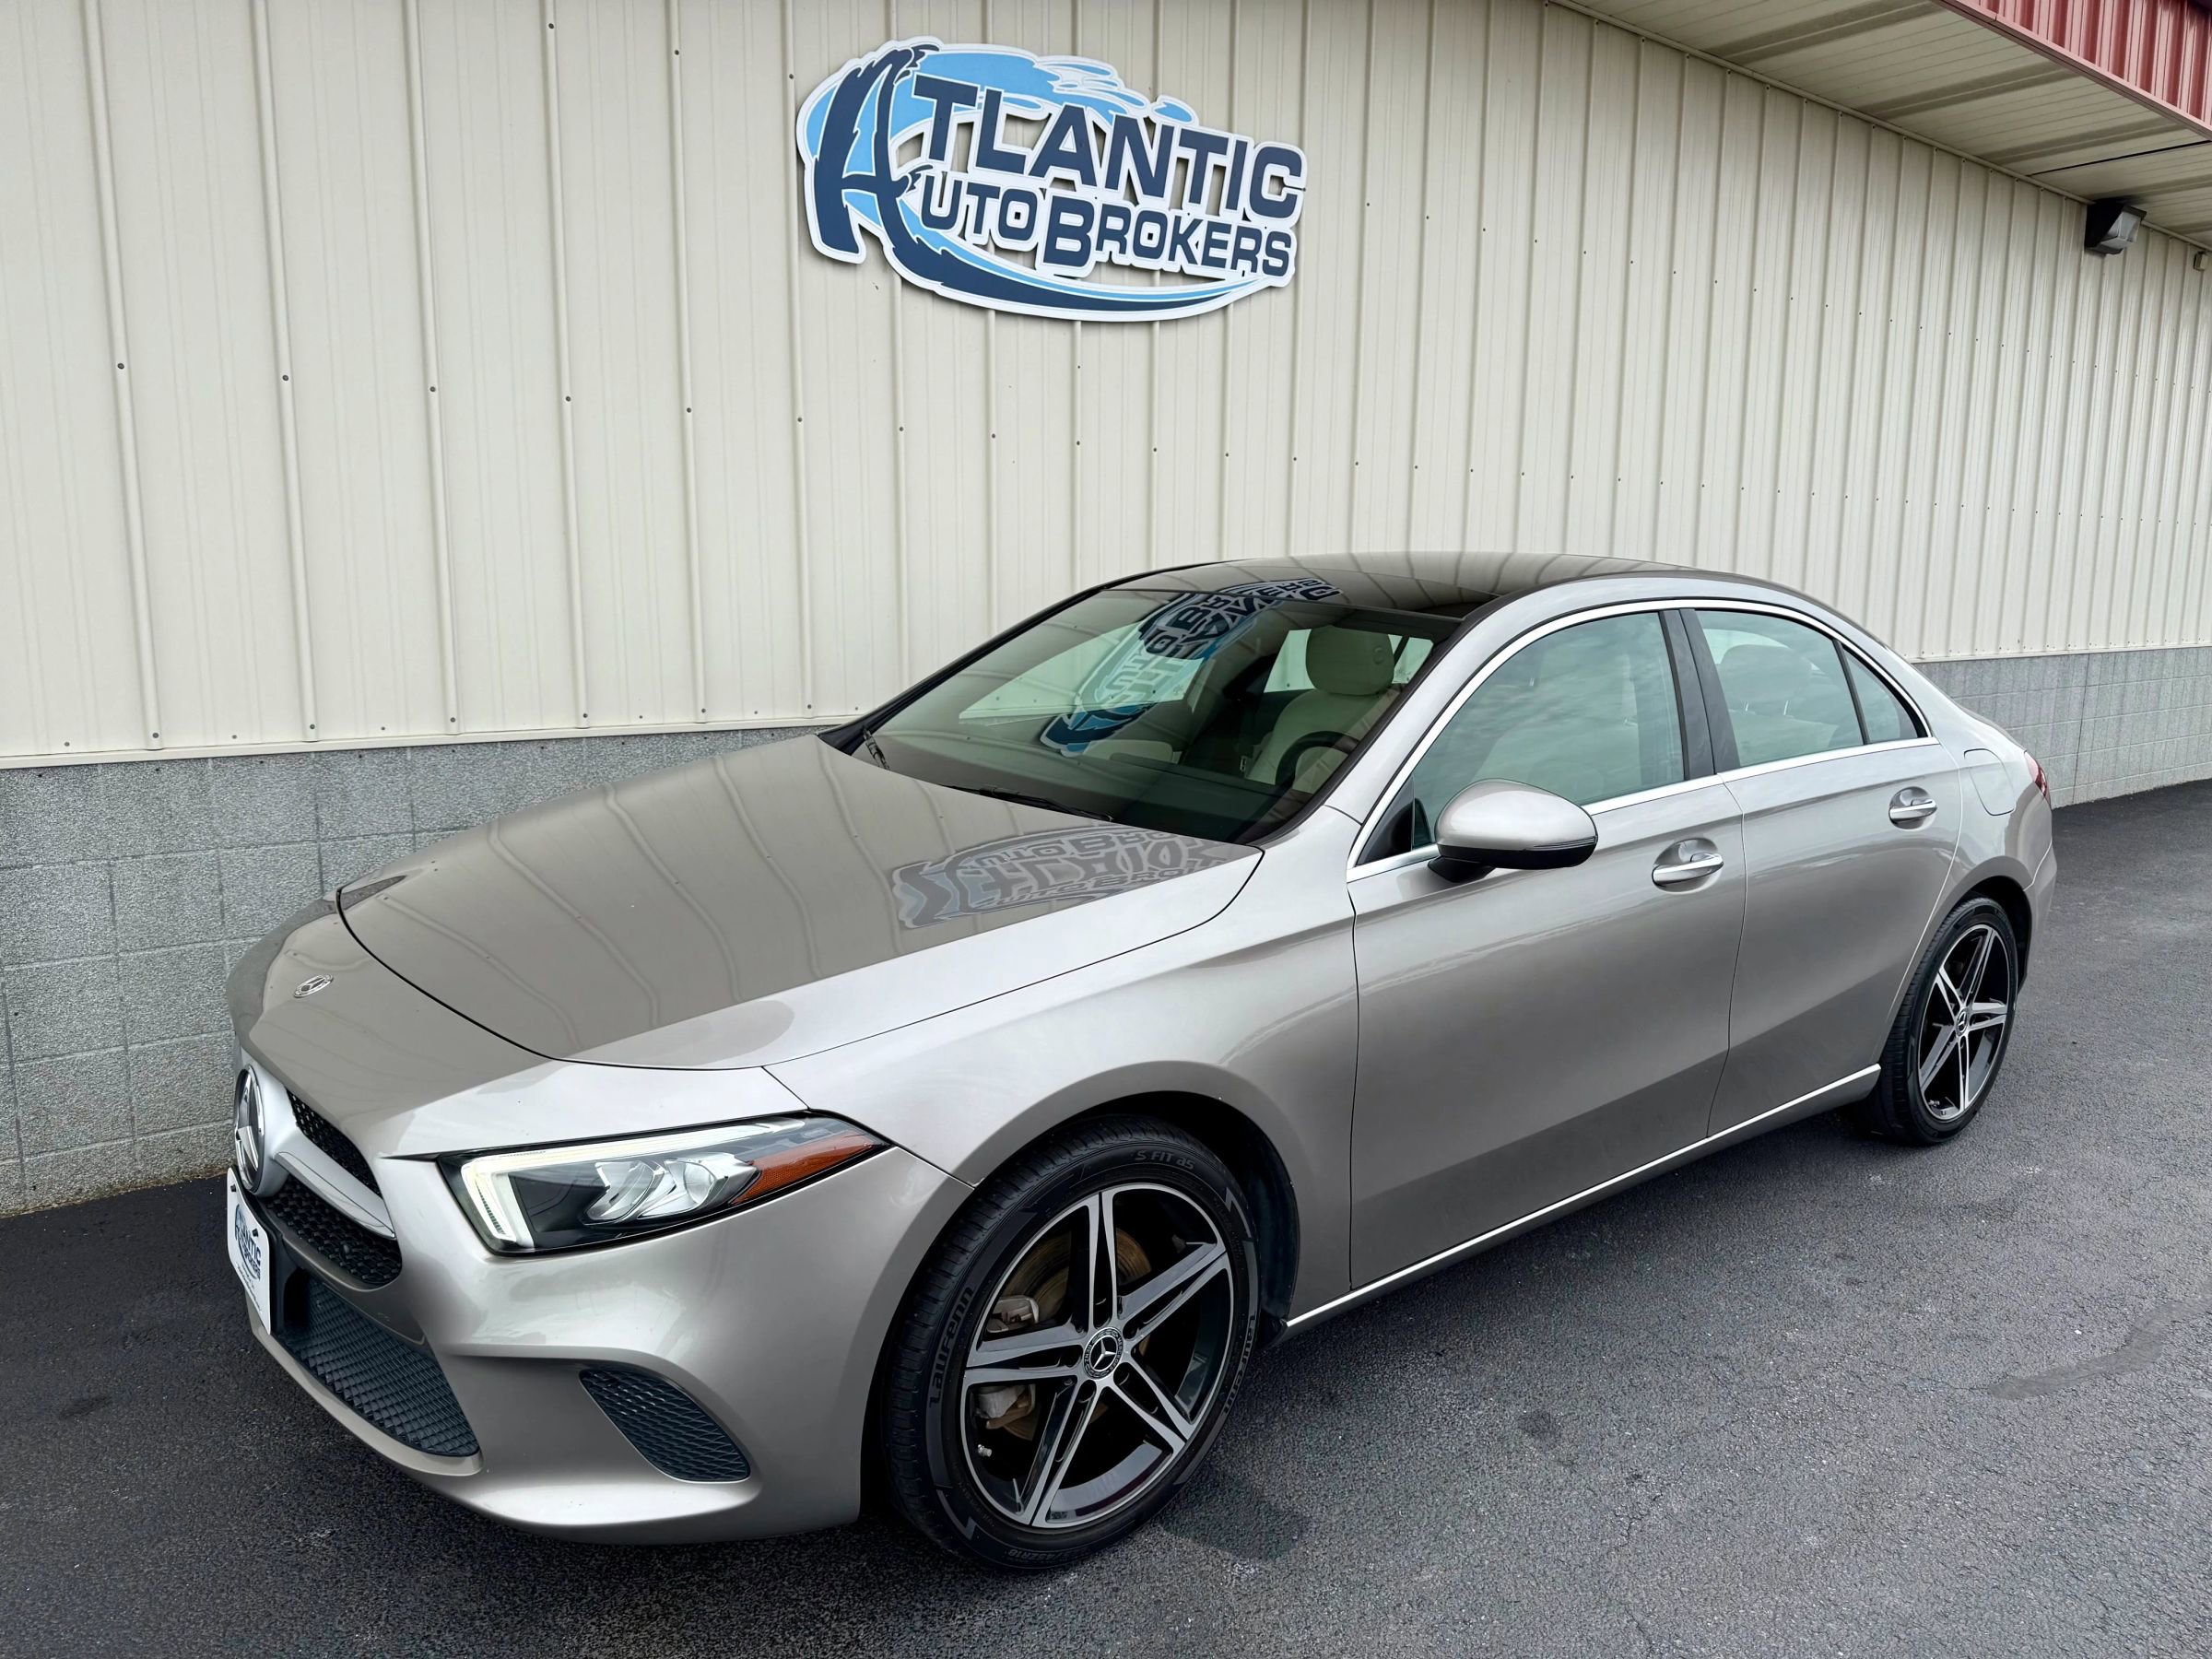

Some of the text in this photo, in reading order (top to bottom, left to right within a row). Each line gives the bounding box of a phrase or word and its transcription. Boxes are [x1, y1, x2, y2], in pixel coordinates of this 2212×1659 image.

[814, 44, 1302, 241] ATLANTIC
[1042, 196, 1291, 276] BROKERS
[1150, 1150, 1175, 1163] FIT
